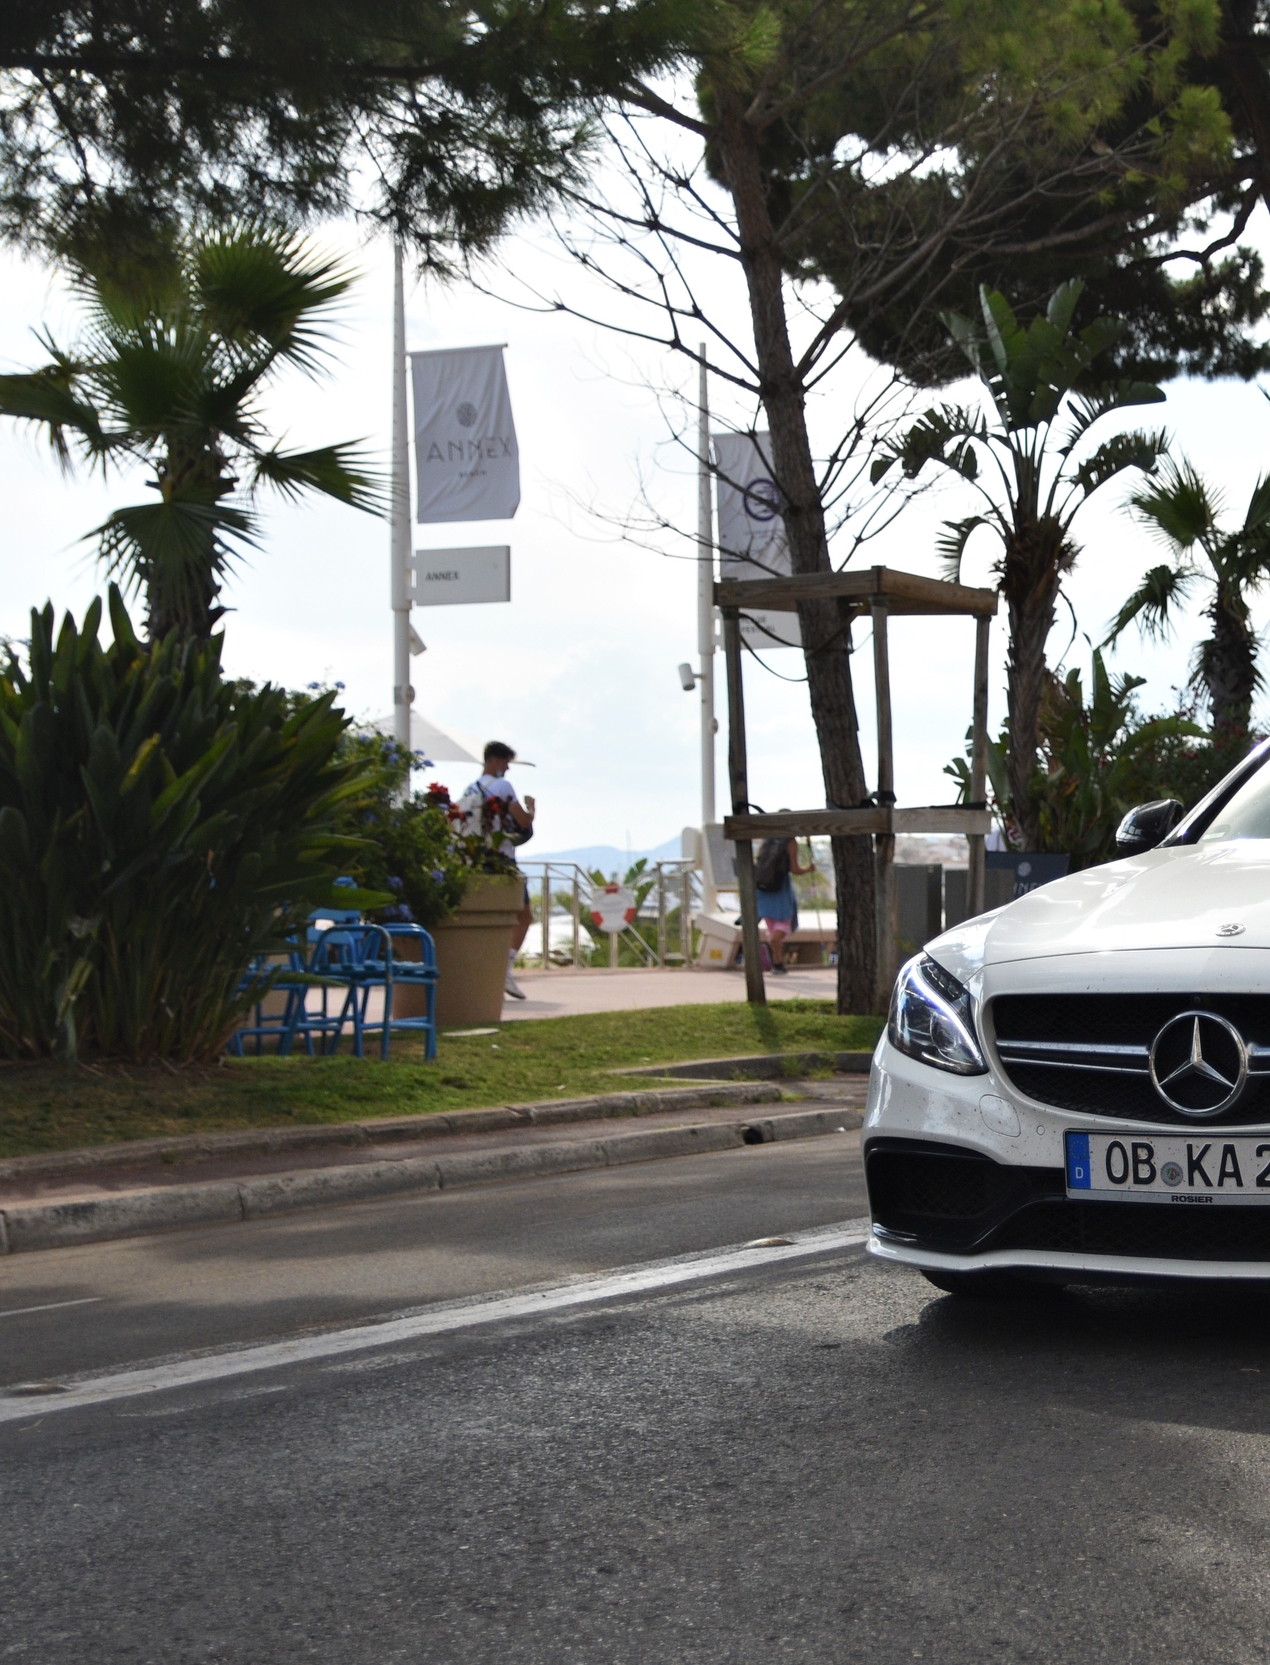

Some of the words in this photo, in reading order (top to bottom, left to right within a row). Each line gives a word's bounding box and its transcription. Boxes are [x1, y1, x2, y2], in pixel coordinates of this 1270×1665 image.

[426, 436, 513, 462] ANNEX
[1074, 1166, 1084, 1179] D
[1105, 1140, 1157, 1185] OB
[1186, 1143, 1244, 1187] KA
[1171, 1194, 1213, 1204] ROSIER
